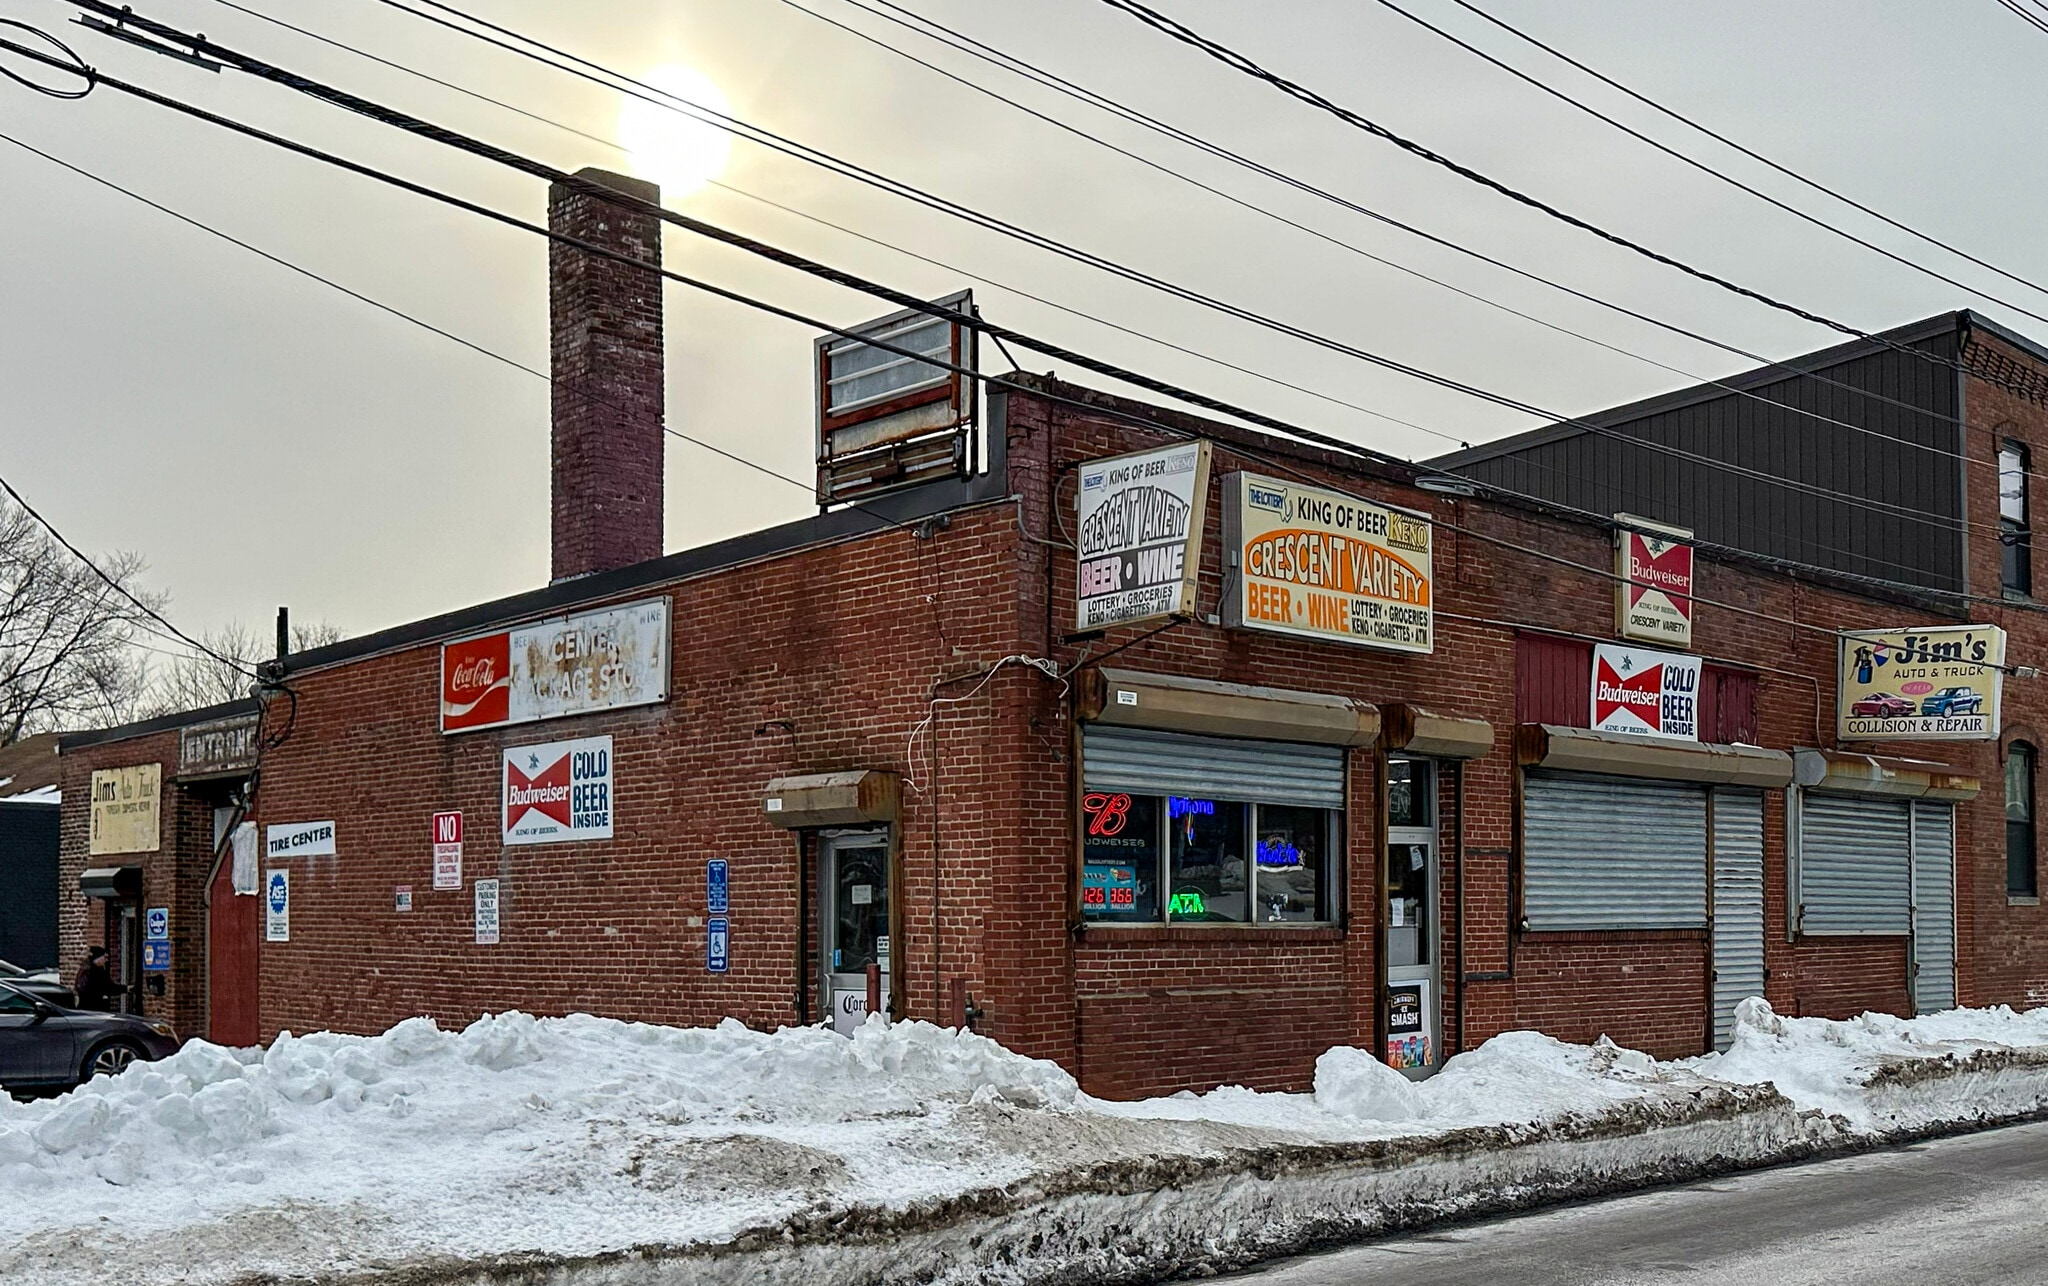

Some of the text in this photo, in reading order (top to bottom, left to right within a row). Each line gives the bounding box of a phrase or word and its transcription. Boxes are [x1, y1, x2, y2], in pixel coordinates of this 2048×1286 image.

[1109, 460, 1166, 486] KING OF BEER
[1081, 485, 1190, 556] CRESCENT VARIETY
[1298, 496, 1388, 536] KING OF BEER
[1387, 511, 1428, 547] KENO
[1081, 544, 1186, 598] BEER WINE
[1248, 532, 1423, 603] CRESCENT VARIETY
[1631, 556, 1690, 587] Budweiser
[1088, 586, 1173, 612] LOTTERY GROCERIES
[1088, 599, 1170, 625] KENO CIGARETTES ATM
[1248, 582, 1349, 632] BEER WINE
[1351, 599, 1428, 627] LOTTERY GROCERIES
[1631, 614, 1686, 633] CRESCENT VARIETY
[1352, 620, 1428, 644] KENO CIGARETTES ATM
[1895, 633, 1987, 664] Jim's
[1663, 664, 1695, 693] COLD
[1894, 666, 1984, 679] AUTO & TRUCK
[1598, 680, 1660, 706] Budweiser
[1663, 694, 1693, 722] BEER
[1663, 721, 1694, 736] INSIDE
[1848, 718, 1983, 733] COLLISION & REPAIR
[186, 727, 257, 763] ENTRANC
[573, 749, 608, 780] COLD
[93, 776, 116, 802] Jims
[508, 781, 570, 806] Budweiser
[573, 782, 608, 813] BEER
[439, 815, 457, 842] NO
[573, 812, 609, 829] INSIDE
[269, 826, 333, 853] TIRE CENTER
[1084, 838, 1146, 848] UDWEISER
[481, 900, 494, 908] ONLY
[1110, 888, 1133, 903] 366
[843, 994, 868, 1016] Coro
[1391, 1012, 1419, 1027] SMASH
